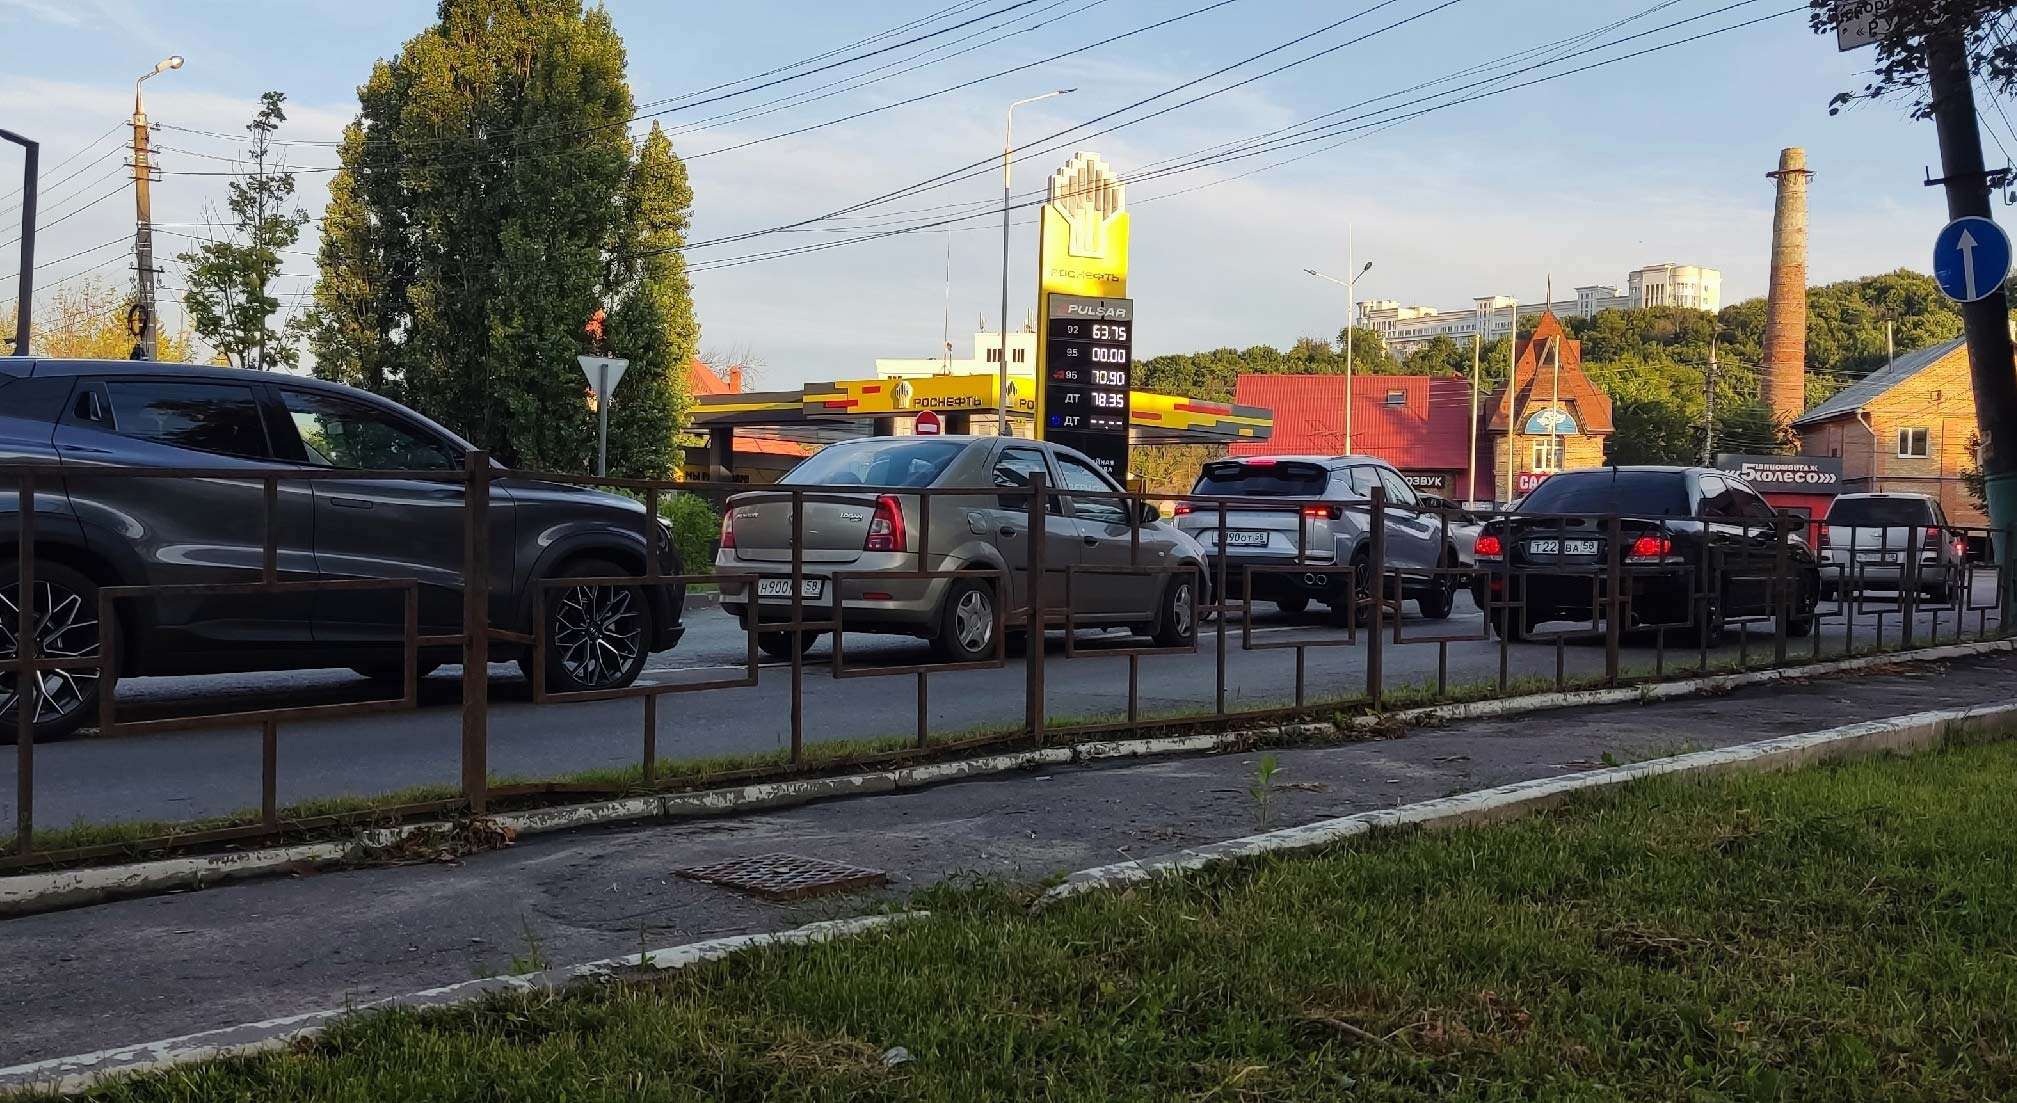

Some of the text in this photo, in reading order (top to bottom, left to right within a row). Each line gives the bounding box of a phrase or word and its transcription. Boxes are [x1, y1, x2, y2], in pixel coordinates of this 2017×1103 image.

[1067, 304, 1127, 318] PULSAR
[1092, 324, 1127, 341] 63.75
[1066, 347, 1126, 363] 95 00.00
[1091, 370, 1126, 386] 70.90
[913, 395, 982, 409] РОСНЕФТЬ
[1064, 392, 1124, 408] ДТ 78.35
[1063, 415, 1081, 427] ДТ
